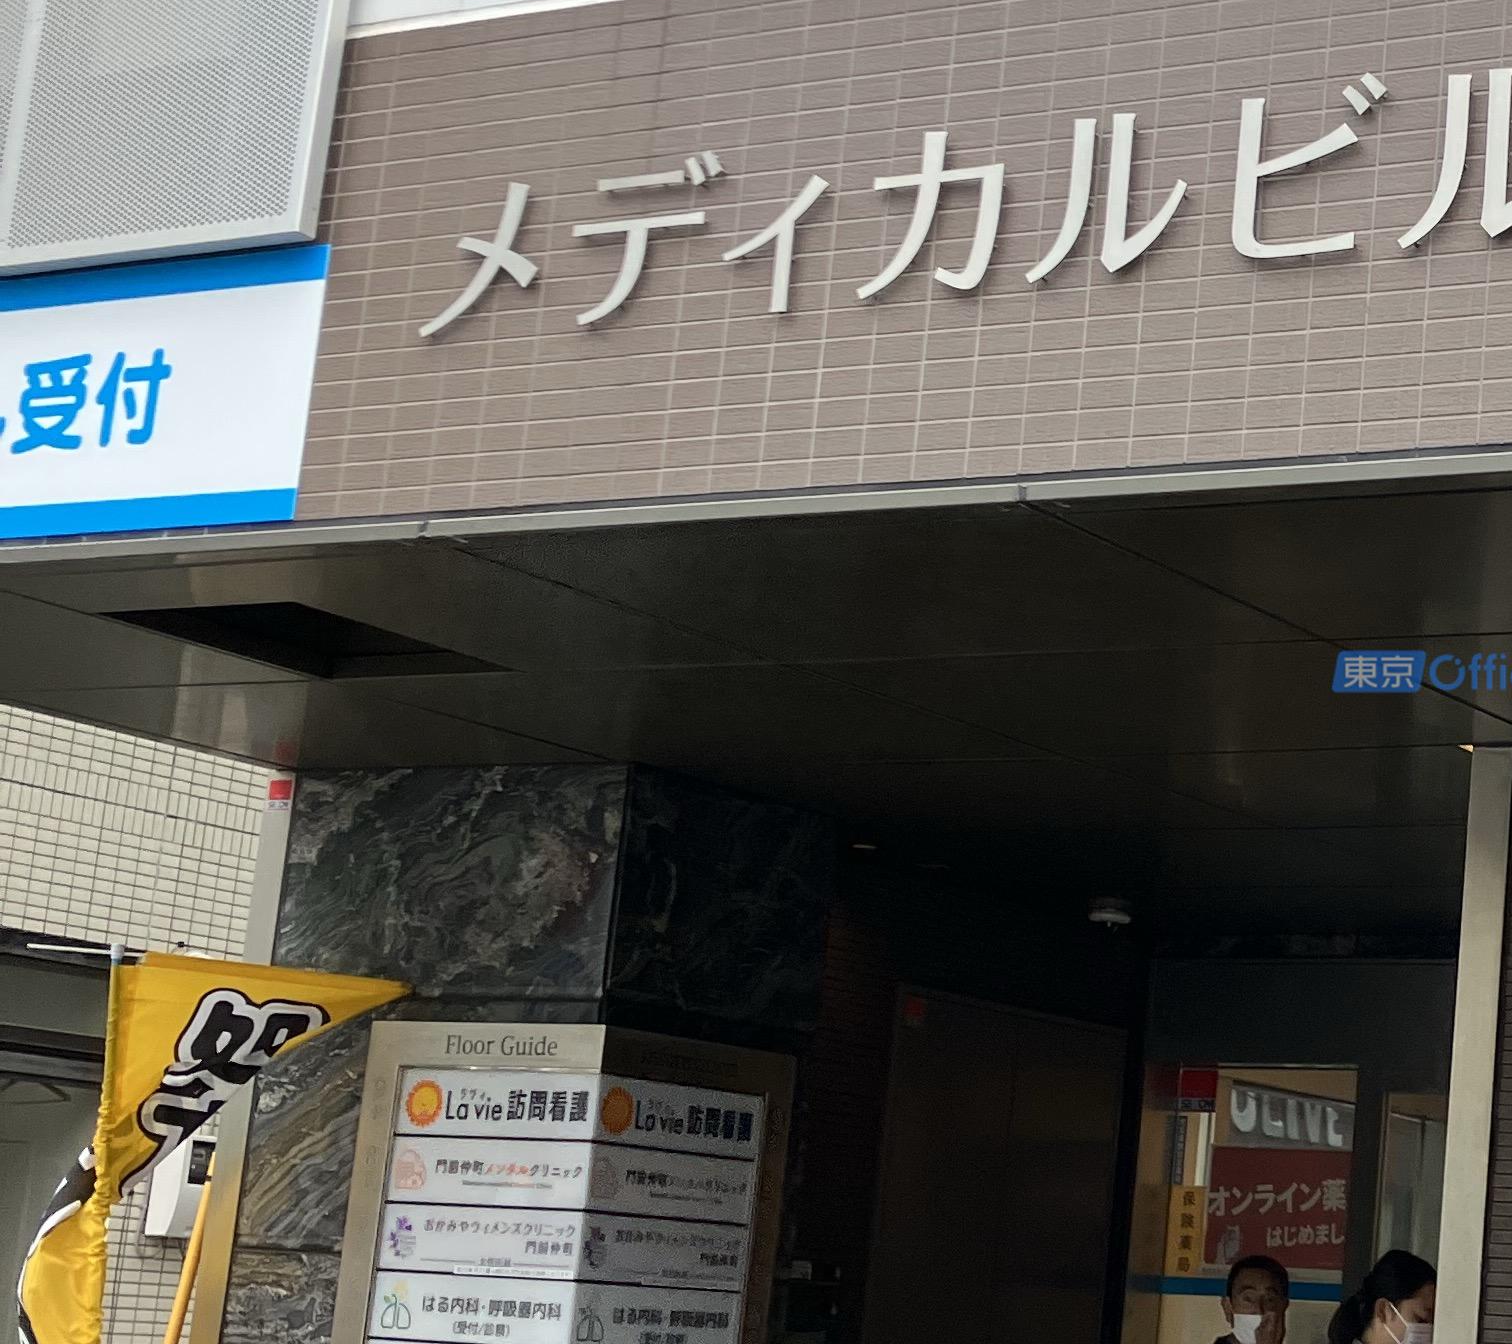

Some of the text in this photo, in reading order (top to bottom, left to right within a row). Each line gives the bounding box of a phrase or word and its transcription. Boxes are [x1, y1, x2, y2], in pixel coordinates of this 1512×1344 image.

[0, 348, 172, 455] 受付
[444, 1034, 558, 1057] Floor Guide
